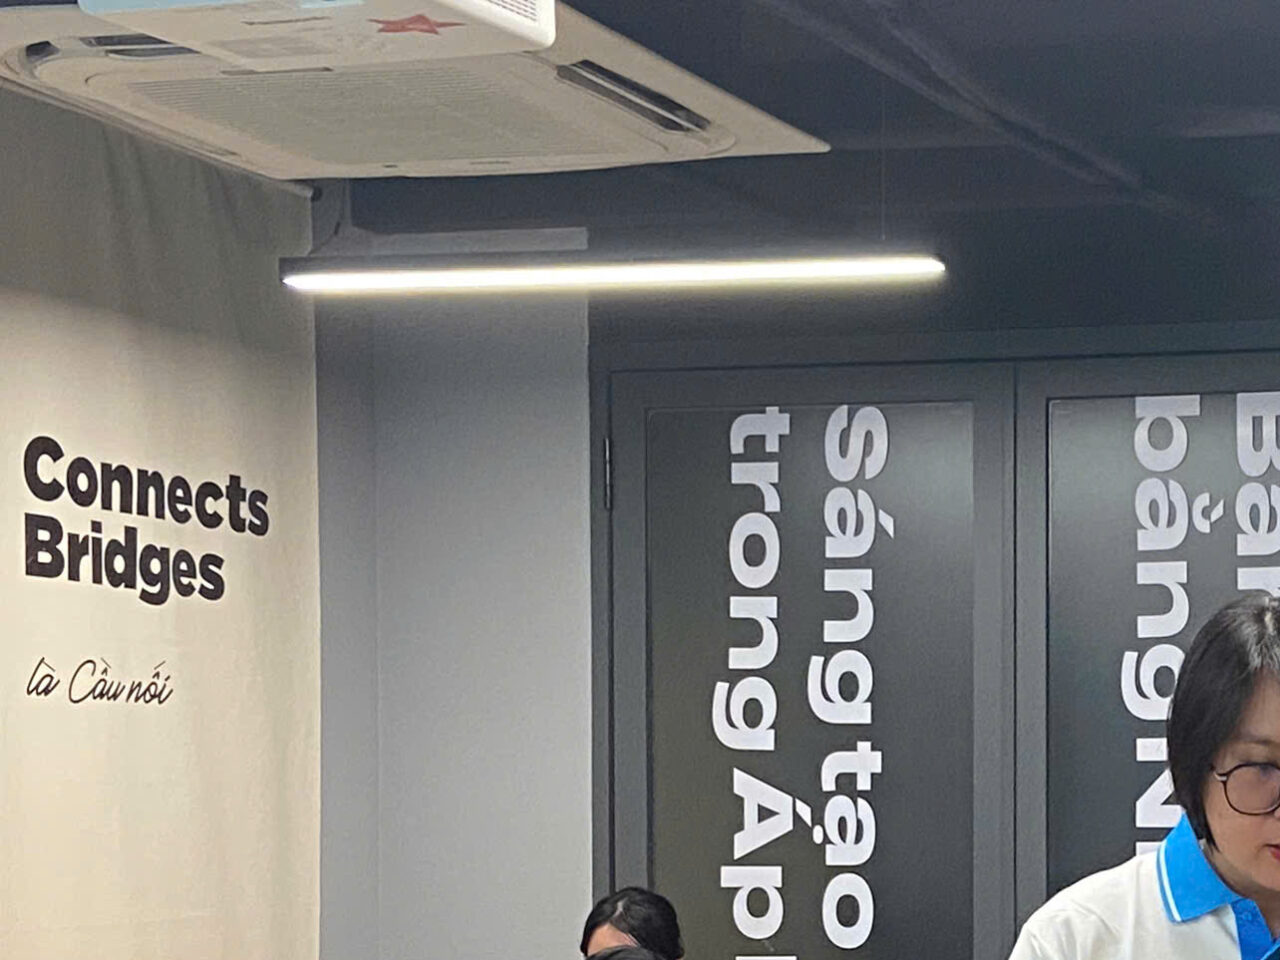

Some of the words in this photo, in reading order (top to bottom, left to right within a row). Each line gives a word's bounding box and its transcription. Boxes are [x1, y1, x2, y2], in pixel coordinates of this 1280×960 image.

[23, 436, 269, 536] Connects
[24, 512, 225, 605] Bridges
[711, 407, 790, 750] trong
[808, 405, 894, 724] Sáng
[1121, 395, 1224, 721] bằng
[26, 657, 60, 697] là
[68, 657, 126, 704] Cầu
[125, 660, 173, 704] nối
[720, 767, 812, 940] Áp
[813, 741, 882, 949] tạo
